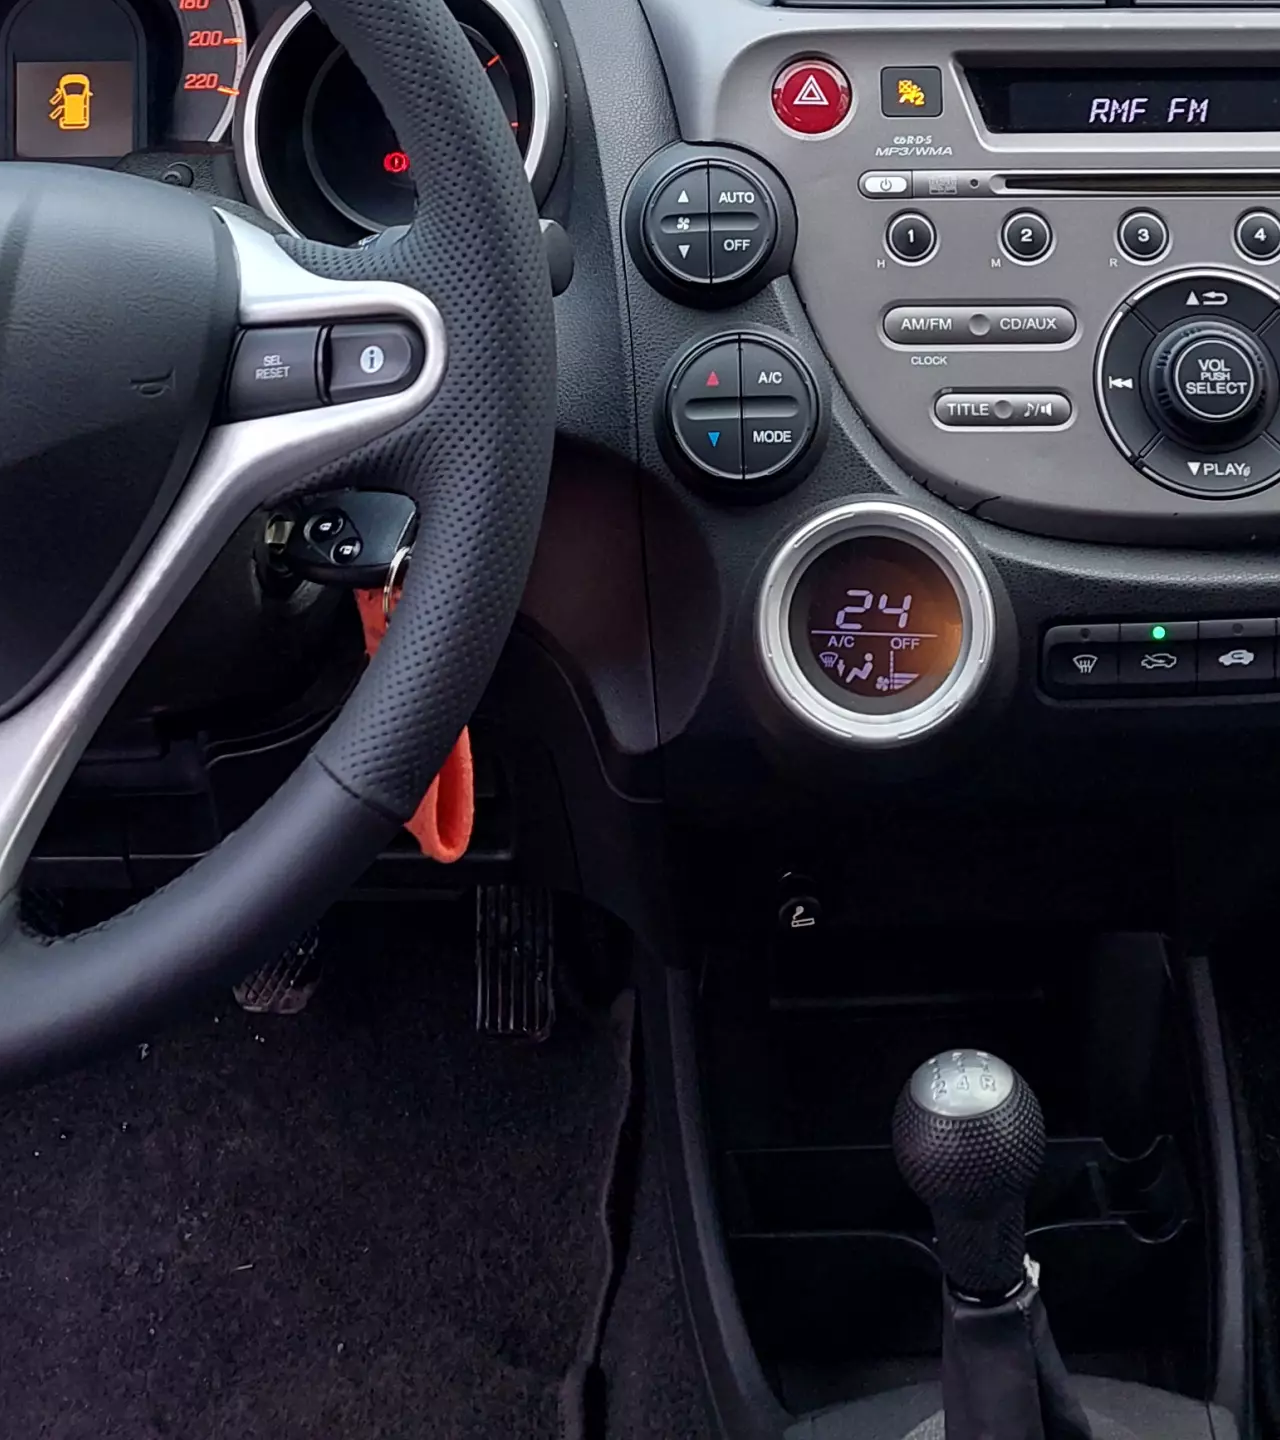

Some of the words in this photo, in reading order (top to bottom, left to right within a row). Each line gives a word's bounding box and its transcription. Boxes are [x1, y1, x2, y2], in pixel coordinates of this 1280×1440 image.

[188, 30, 223, 47] 200
[184, 73, 219, 90] 220
[1088, 98, 1148, 123] RMF
[1167, 98, 1209, 123] FM
[875, 146, 953, 157] MP3/WMA
[718, 191, 755, 204] AUTO
[907, 228, 916, 244] 1
[1020, 228, 1033, 243] 2
[1137, 228, 1150, 243] 3
[1254, 228, 1267, 242] 4
[723, 238, 751, 252] OFF
[877, 259, 886, 268] H
[991, 258, 1001, 268] M
[1110, 258, 1118, 267] R
[900, 316, 952, 331] AM/FM
[999, 316, 1057, 332] CD/AUX
[263, 354, 283, 367] SEL
[910, 355, 948, 365] CLOCK
[1197, 359, 1231, 372] VOL
[255, 366, 291, 380] RESET
[757, 371, 783, 385] A/C
[1200, 372, 1231, 381] PUSH
[1185, 382, 1248, 395] SELECT
[946, 402, 989, 417] TITLE
[752, 430, 792, 444] MODE
[1203, 462, 1246, 476] PLAY
[835, 589, 912, 630] 24
[827, 635, 855, 648] A/C
[890, 637, 920, 649] OFF
